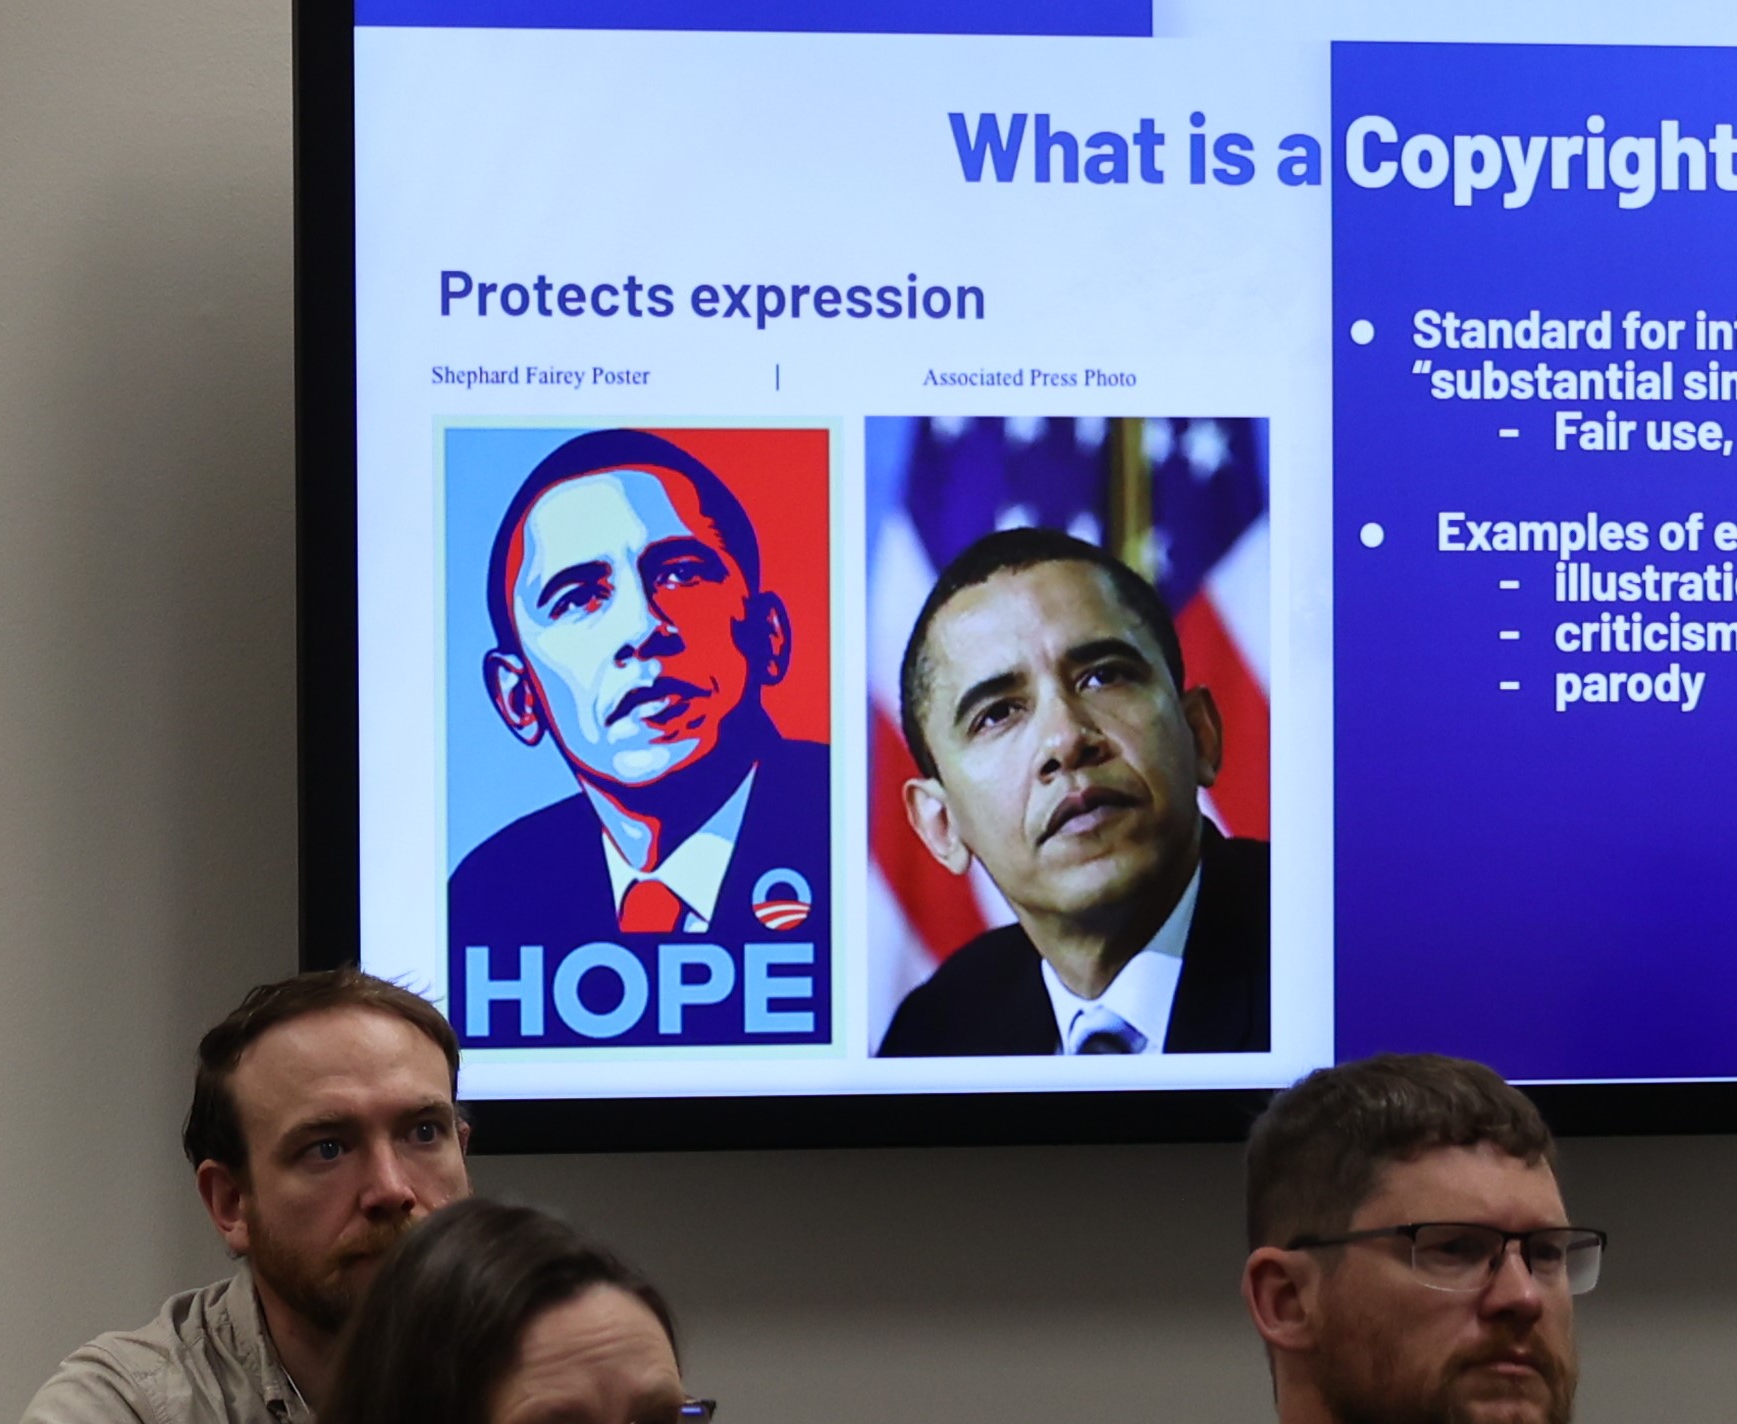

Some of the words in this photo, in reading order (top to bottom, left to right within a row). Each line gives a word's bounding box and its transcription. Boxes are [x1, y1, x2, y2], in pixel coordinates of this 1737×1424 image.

[947, 112, 1165, 185] What
[1189, 110, 1256, 186] is
[1277, 133, 1322, 187] a
[440, 270, 674, 318] Protects
[690, 272, 985, 330] expression
[1413, 309, 1612, 350] Standard
[1622, 310, 1686, 350] for
[432, 366, 519, 390] Shephard
[526, 366, 585, 390] Fairey
[592, 366, 650, 385] Poster
[923, 368, 1024, 387] Associated
[1030, 368, 1078, 387] Press
[1084, 368, 1137, 387] Photo
[1555, 410, 1637, 451] Fair
[1646, 420, 1733, 456] use,
[1438, 511, 1649, 560] Examples
[1659, 512, 1704, 551] of
[1556, 663, 1706, 712] parody
[465, 942, 815, 1039] HOPE
